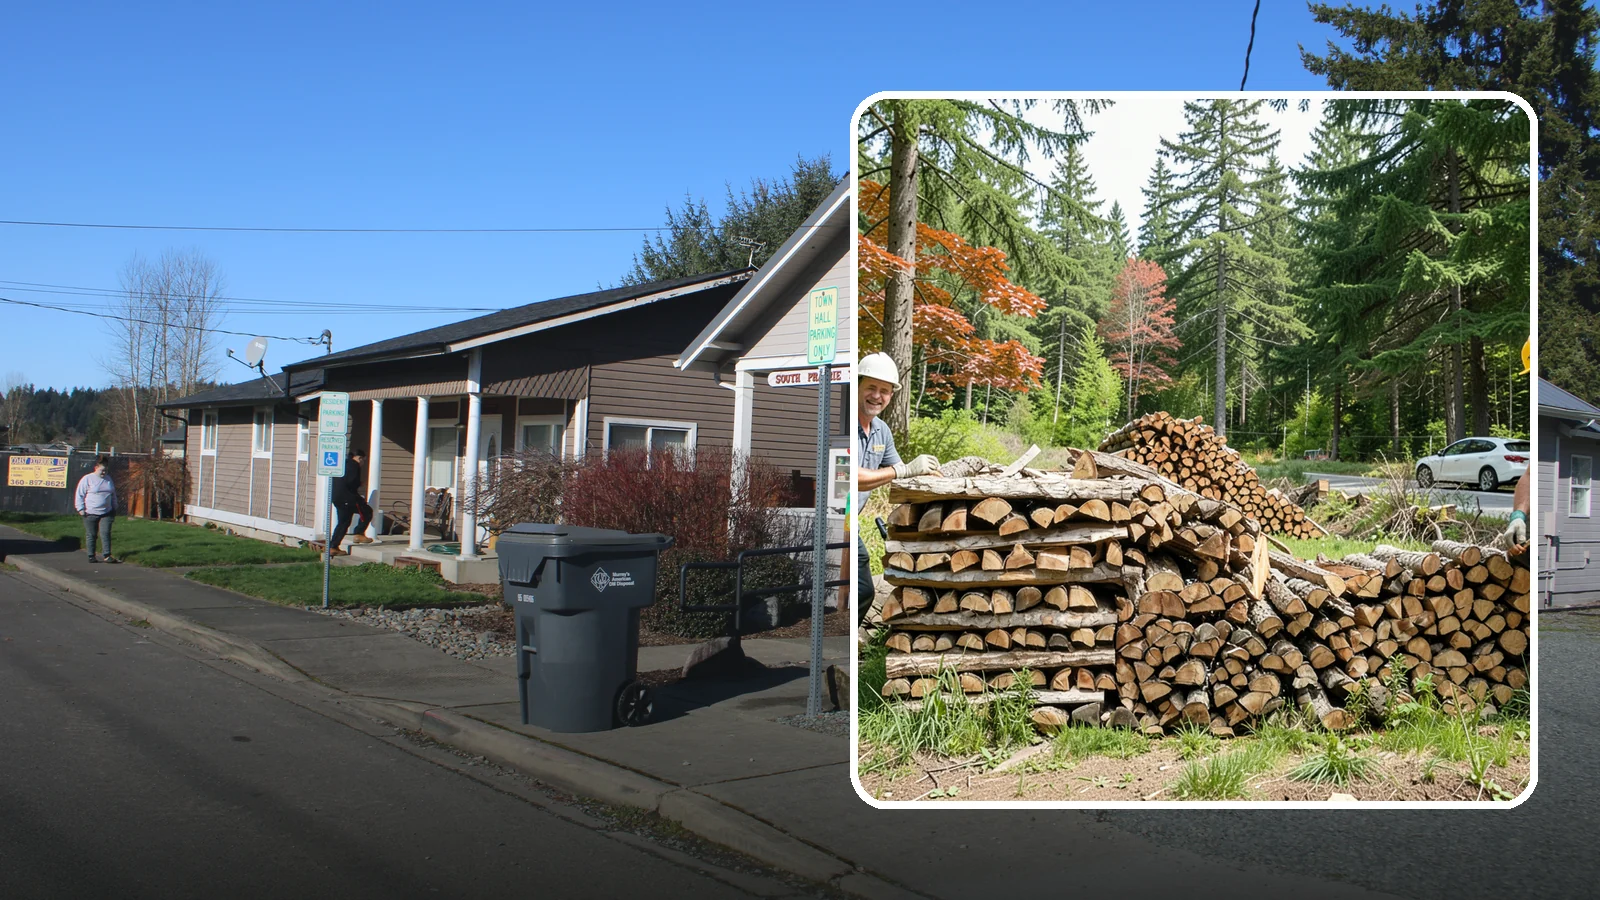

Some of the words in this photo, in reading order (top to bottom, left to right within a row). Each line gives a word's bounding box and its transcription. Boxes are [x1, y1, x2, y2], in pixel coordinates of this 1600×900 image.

[815, 295, 833, 308] TOWN
[814, 311, 831, 324] HALL
[810, 327, 835, 340] PARKING
[813, 344, 830, 357] ONLY
[775, 373, 800, 384] SOUTH
[807, 371, 842, 382] PRIE
